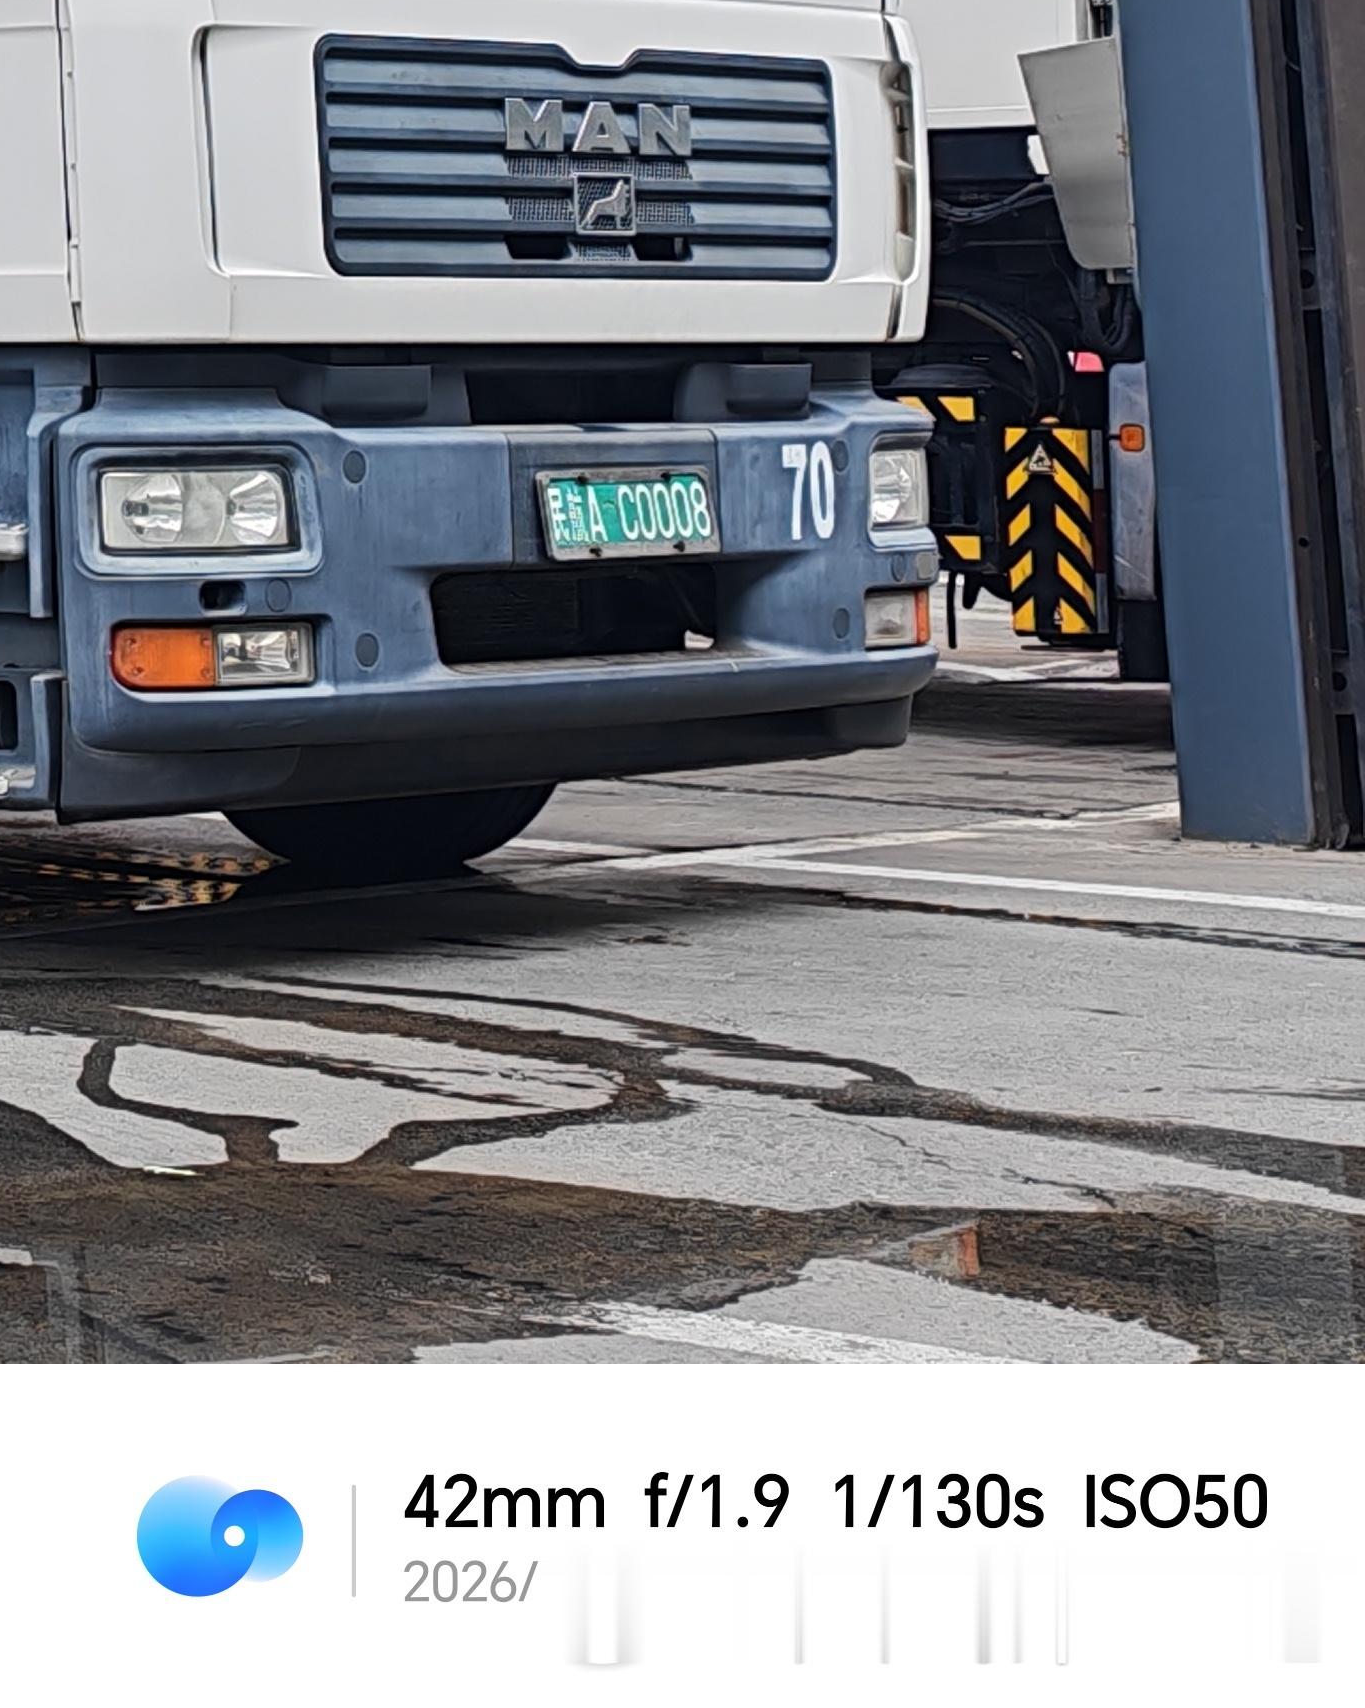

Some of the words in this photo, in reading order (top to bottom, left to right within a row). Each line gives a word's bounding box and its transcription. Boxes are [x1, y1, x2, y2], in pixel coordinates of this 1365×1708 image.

[504, 97, 693, 157] MAN
[617, 481, 712, 541] C0008
[781, 440, 836, 541] 70
